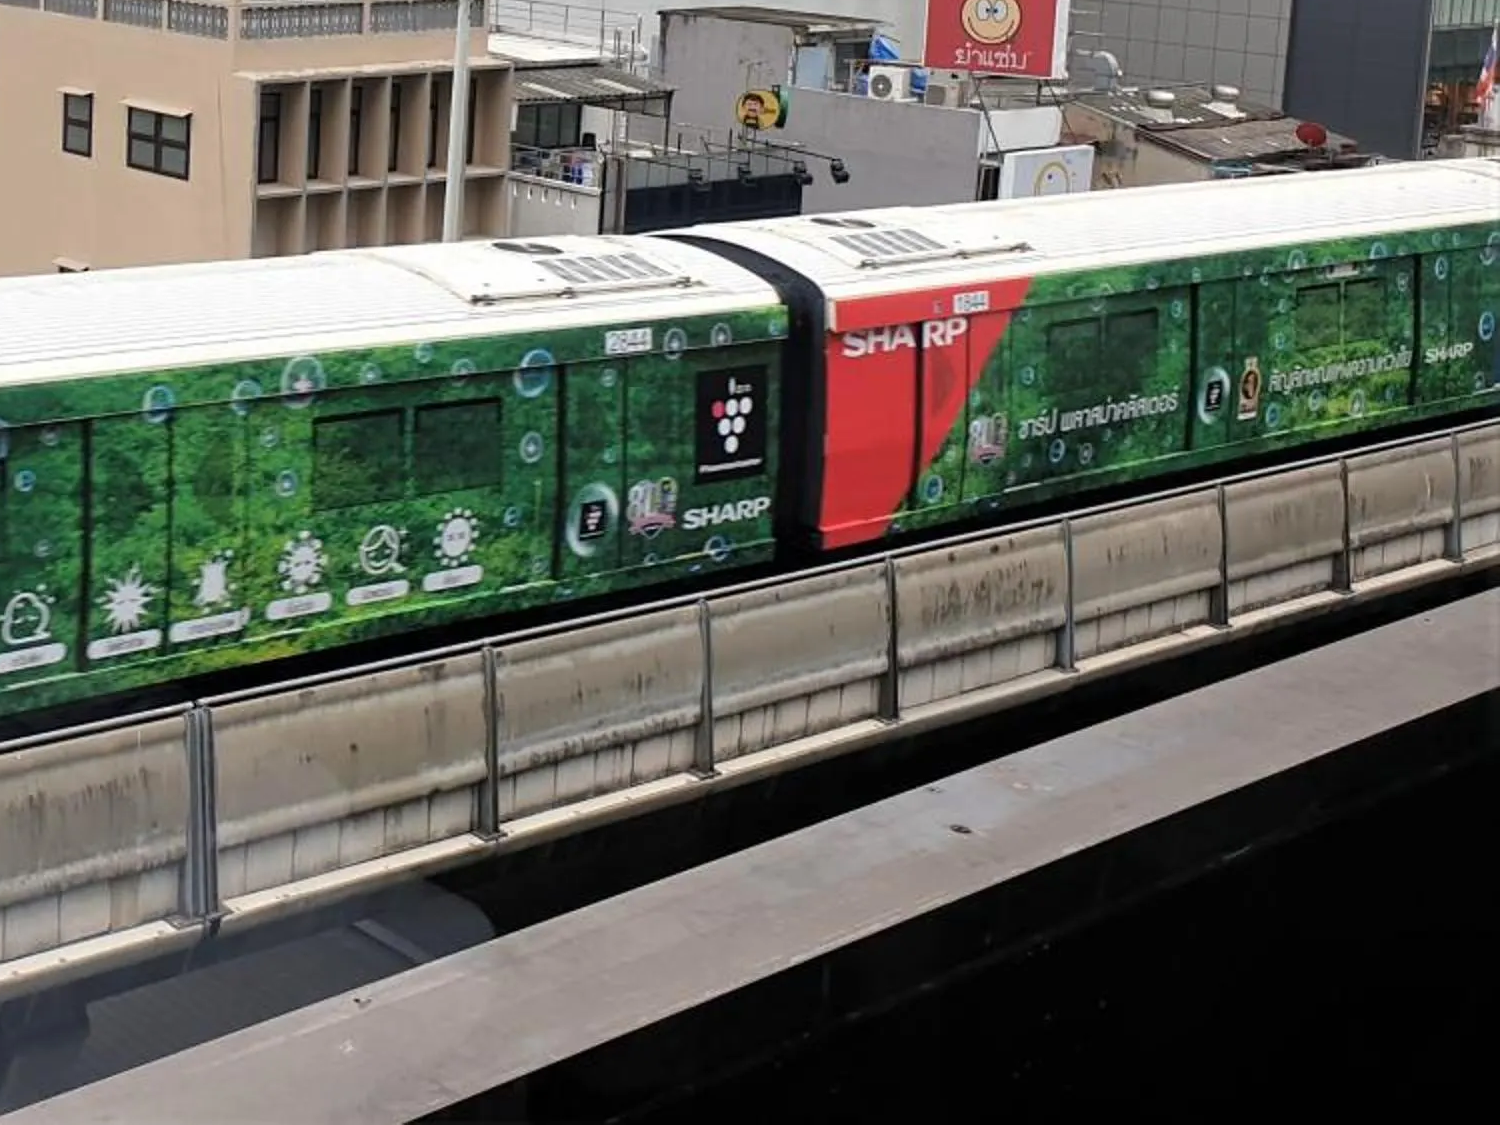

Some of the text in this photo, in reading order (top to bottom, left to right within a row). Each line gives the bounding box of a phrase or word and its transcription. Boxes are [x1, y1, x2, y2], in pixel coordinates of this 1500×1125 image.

[841, 317, 968, 359] SHARP
[1423, 341, 1475, 365] SHARP
[681, 496, 772, 530] SHARP
